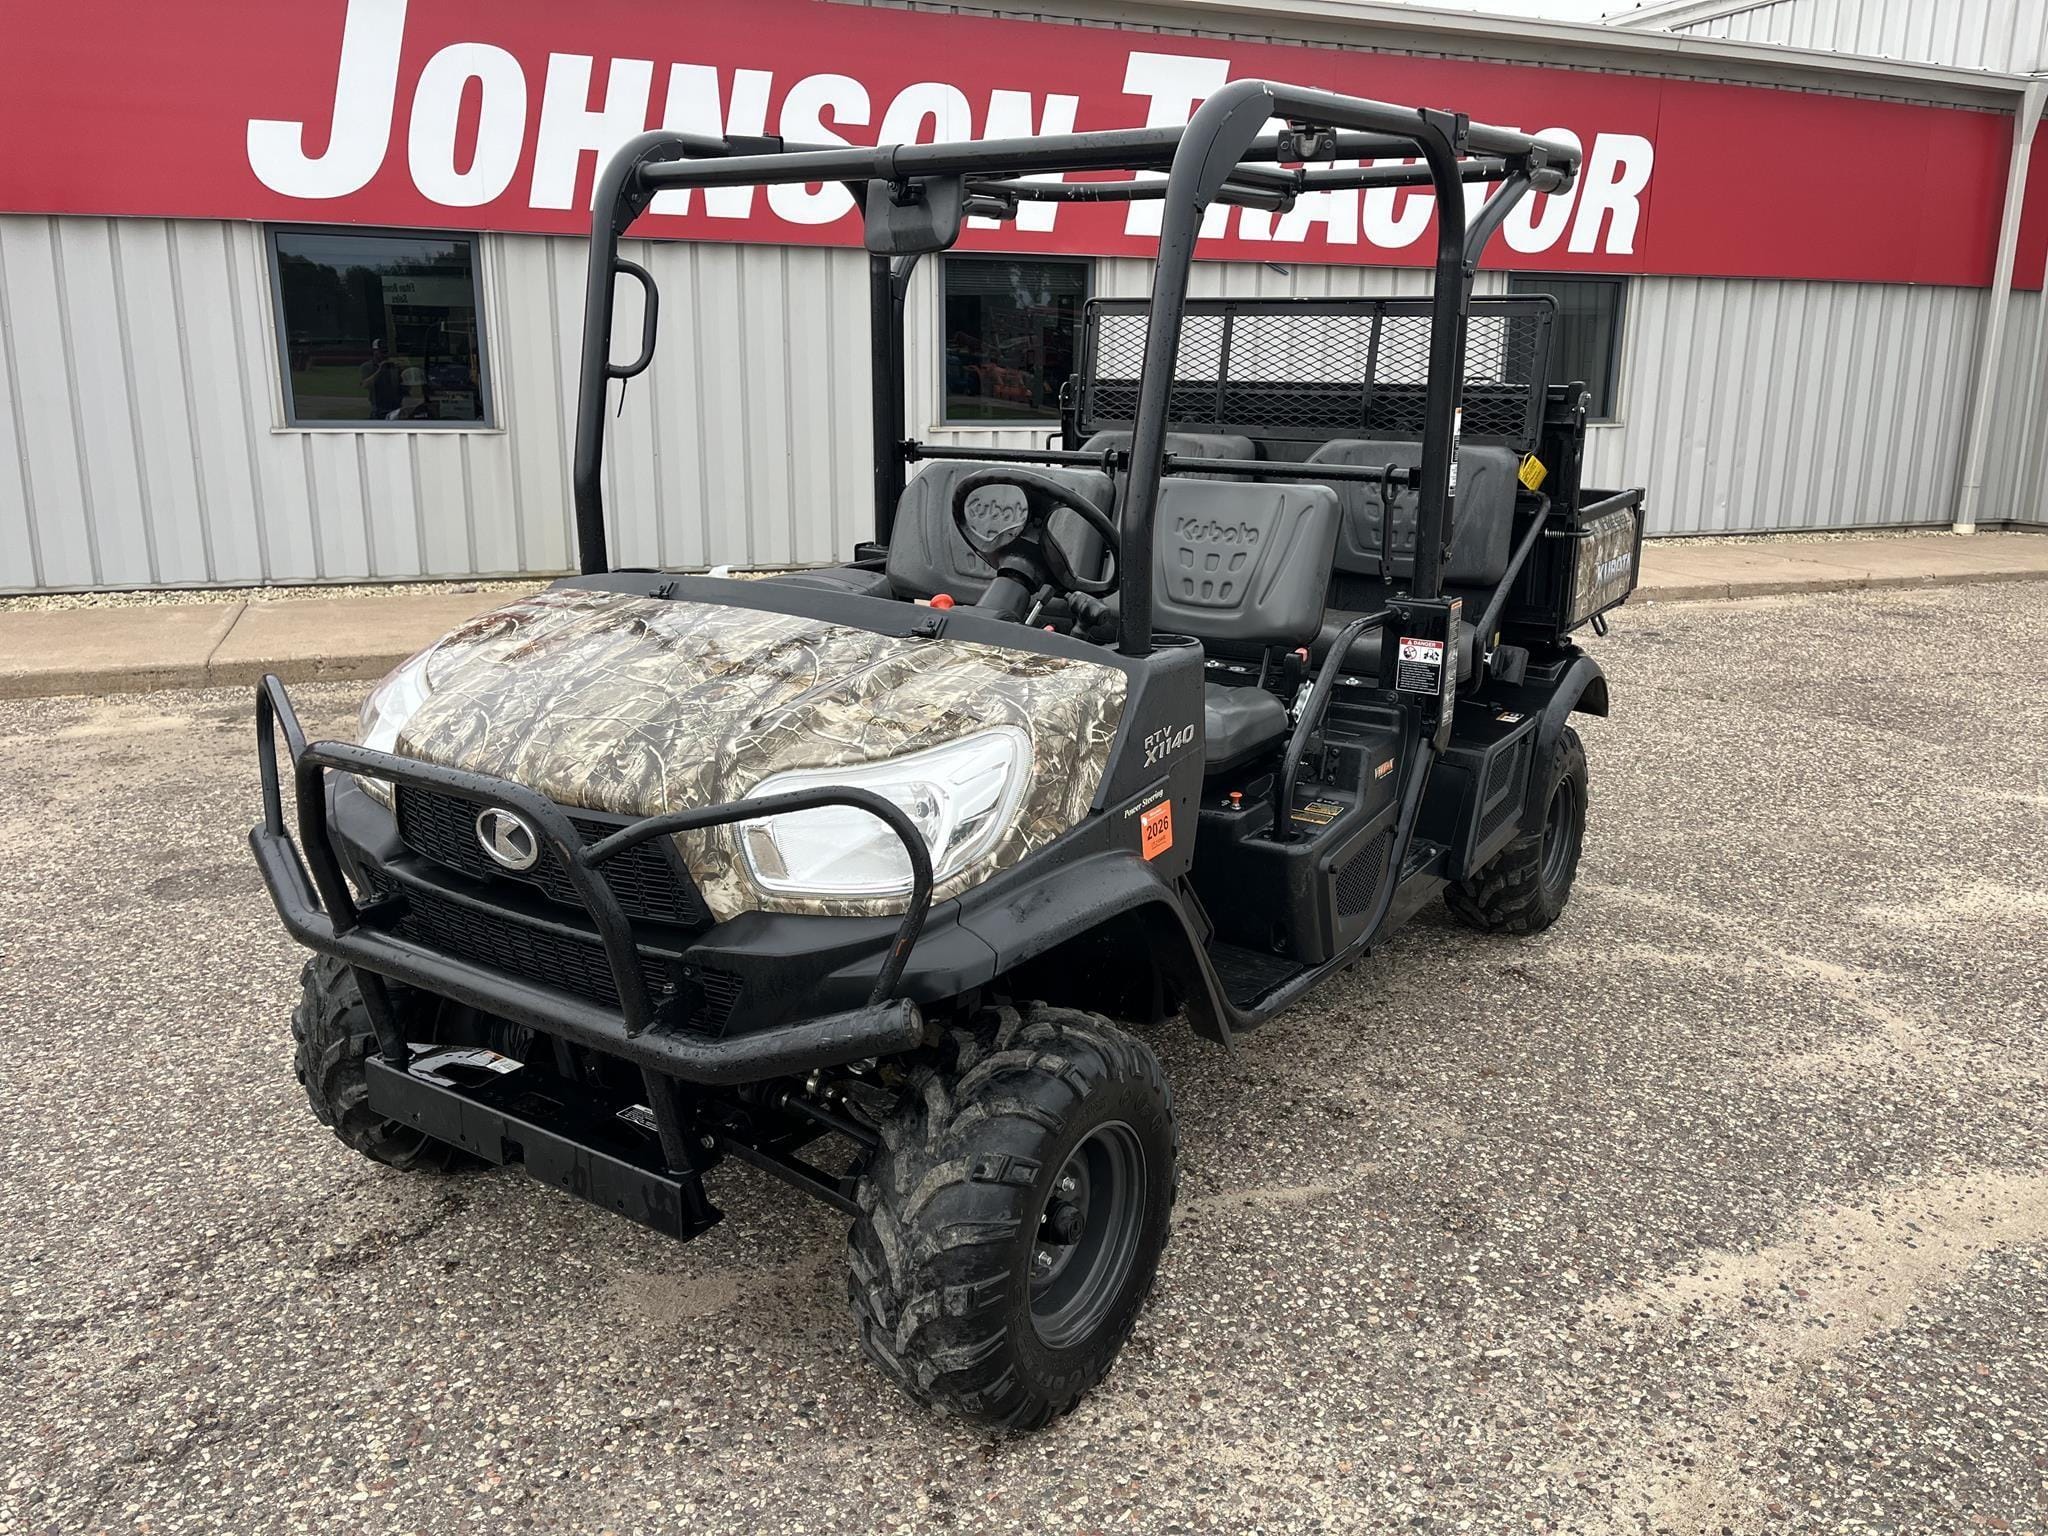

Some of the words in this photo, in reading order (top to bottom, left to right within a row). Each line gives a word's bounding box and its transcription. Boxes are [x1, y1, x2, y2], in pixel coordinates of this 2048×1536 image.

[1122, 51, 1654, 254] TACOR
[1175, 517, 1259, 544] Kubota
[1597, 552, 1631, 582] KUBOTA
[1413, 640, 1436, 648] DANGER
[1143, 723, 1195, 768] X1140
[1144, 725, 1172, 749] RTV
[1124, 803, 1142, 819] Power
[1142, 789, 1164, 808] Steering
[1146, 815, 1169, 842] 2026
